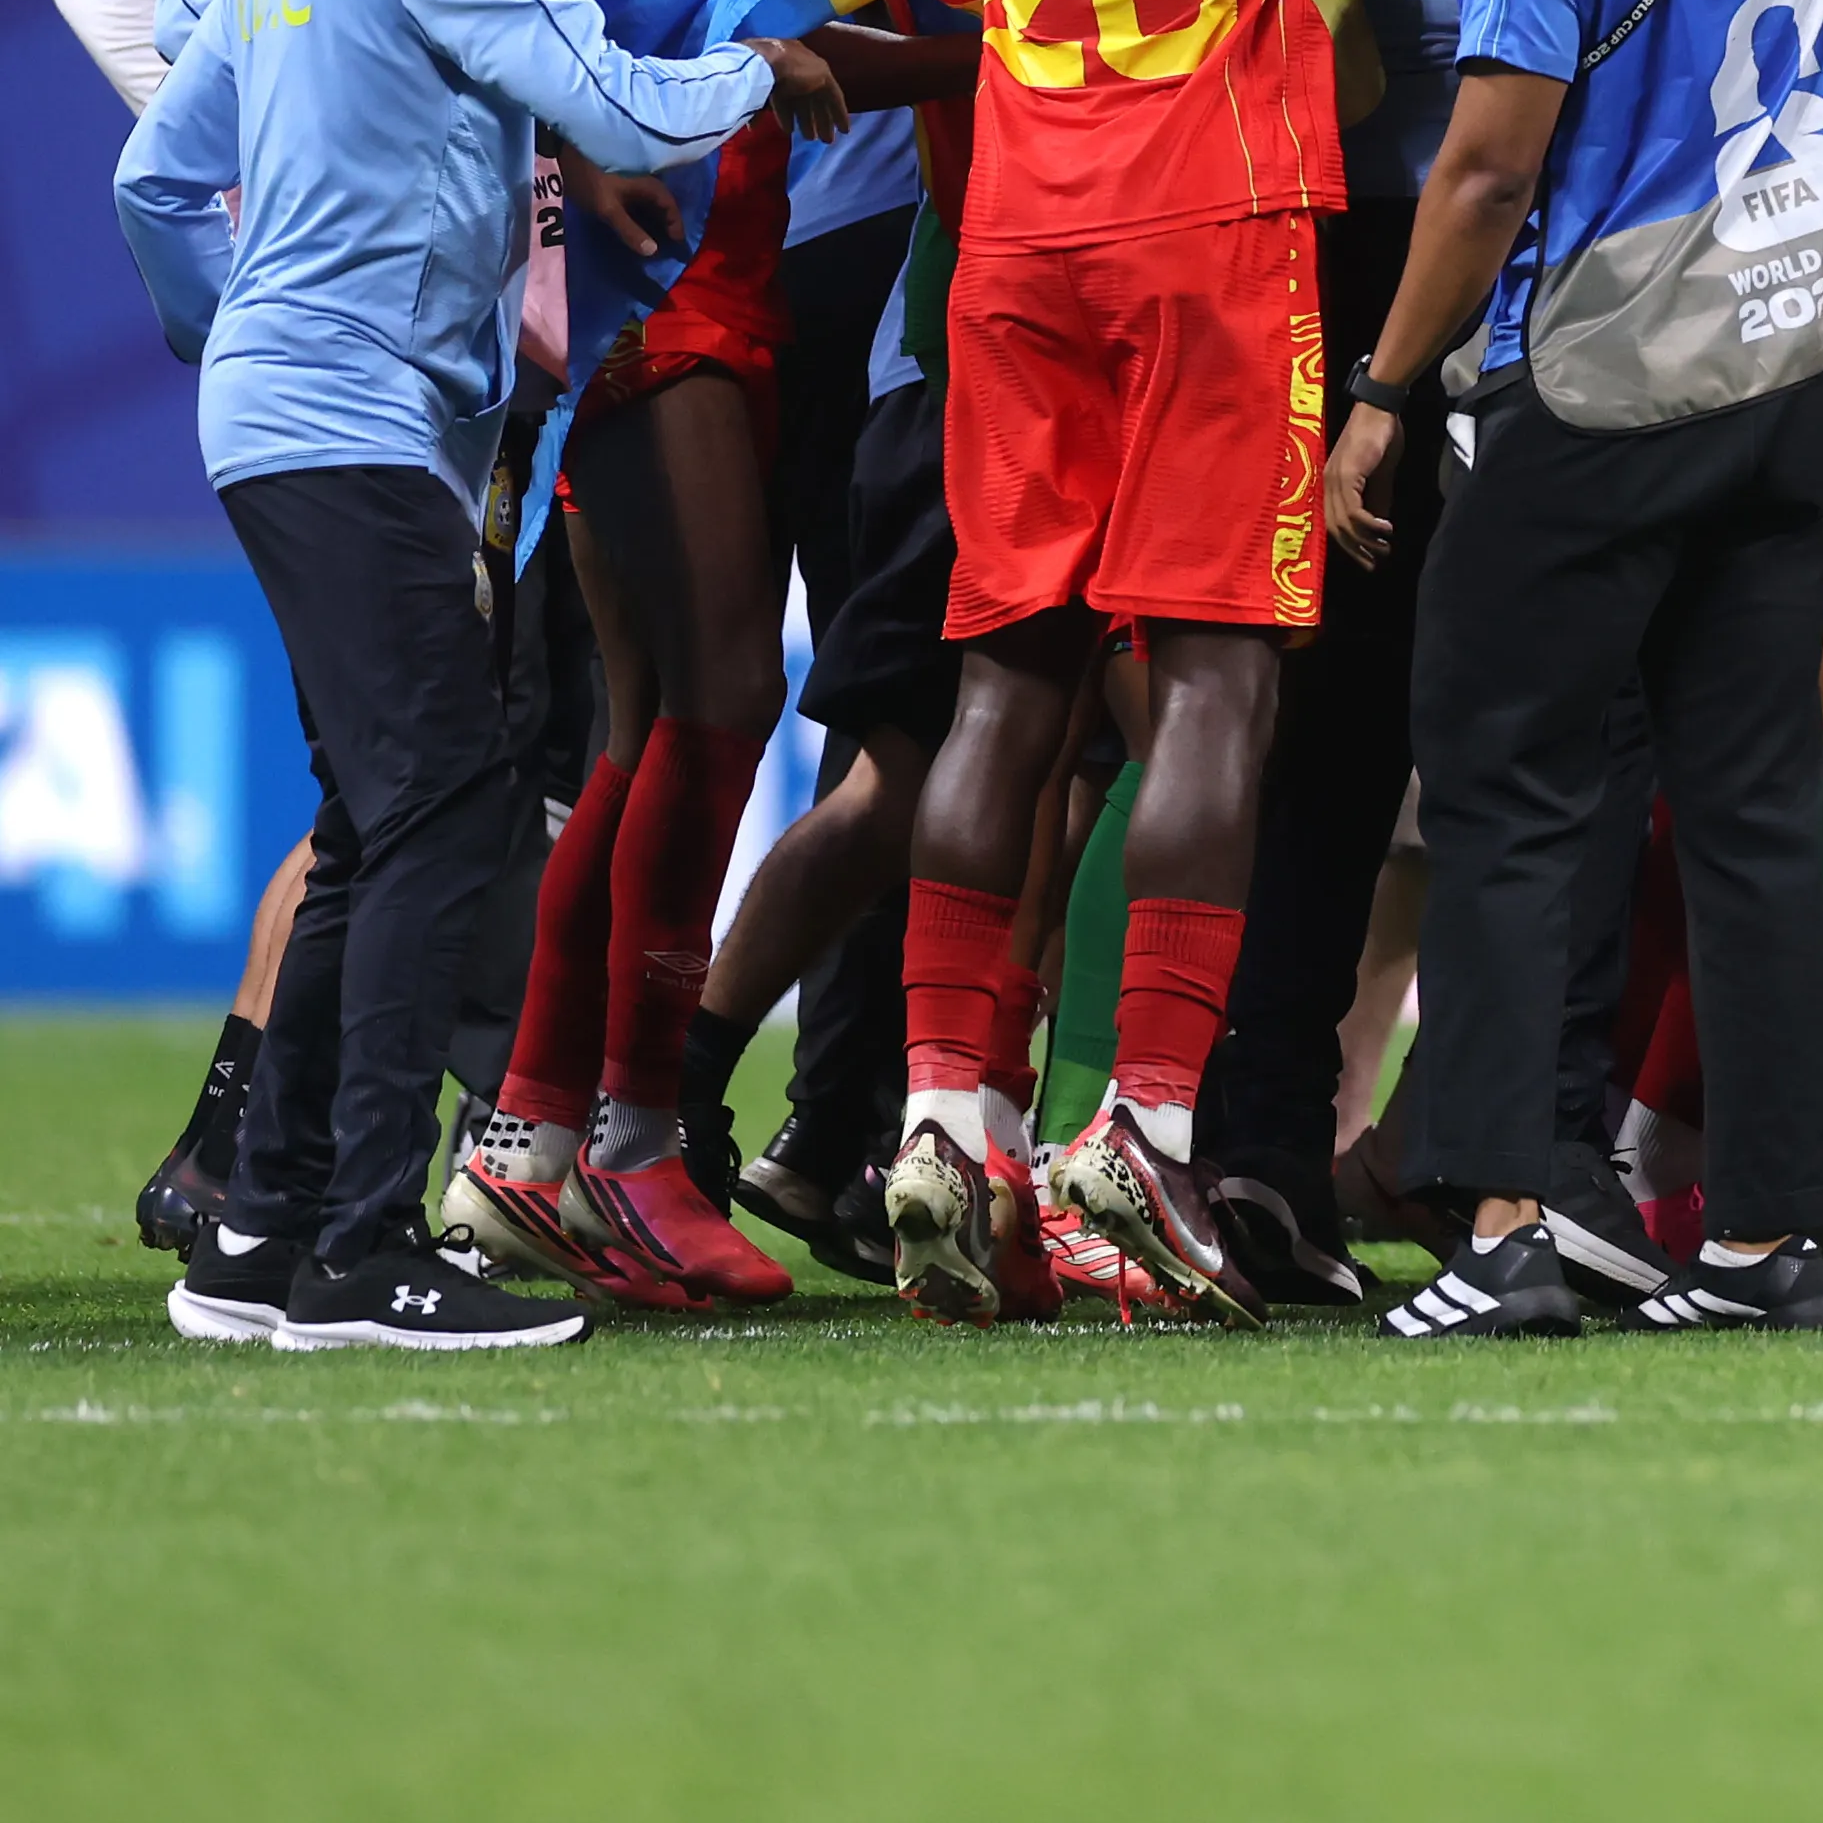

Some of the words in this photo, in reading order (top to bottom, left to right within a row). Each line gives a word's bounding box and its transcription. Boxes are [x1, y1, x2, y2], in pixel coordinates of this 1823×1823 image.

[1610, 19, 1634, 45] CUP
[1742, 177, 1820, 223] FIFA
[1727, 249, 1822, 296] WORLD
